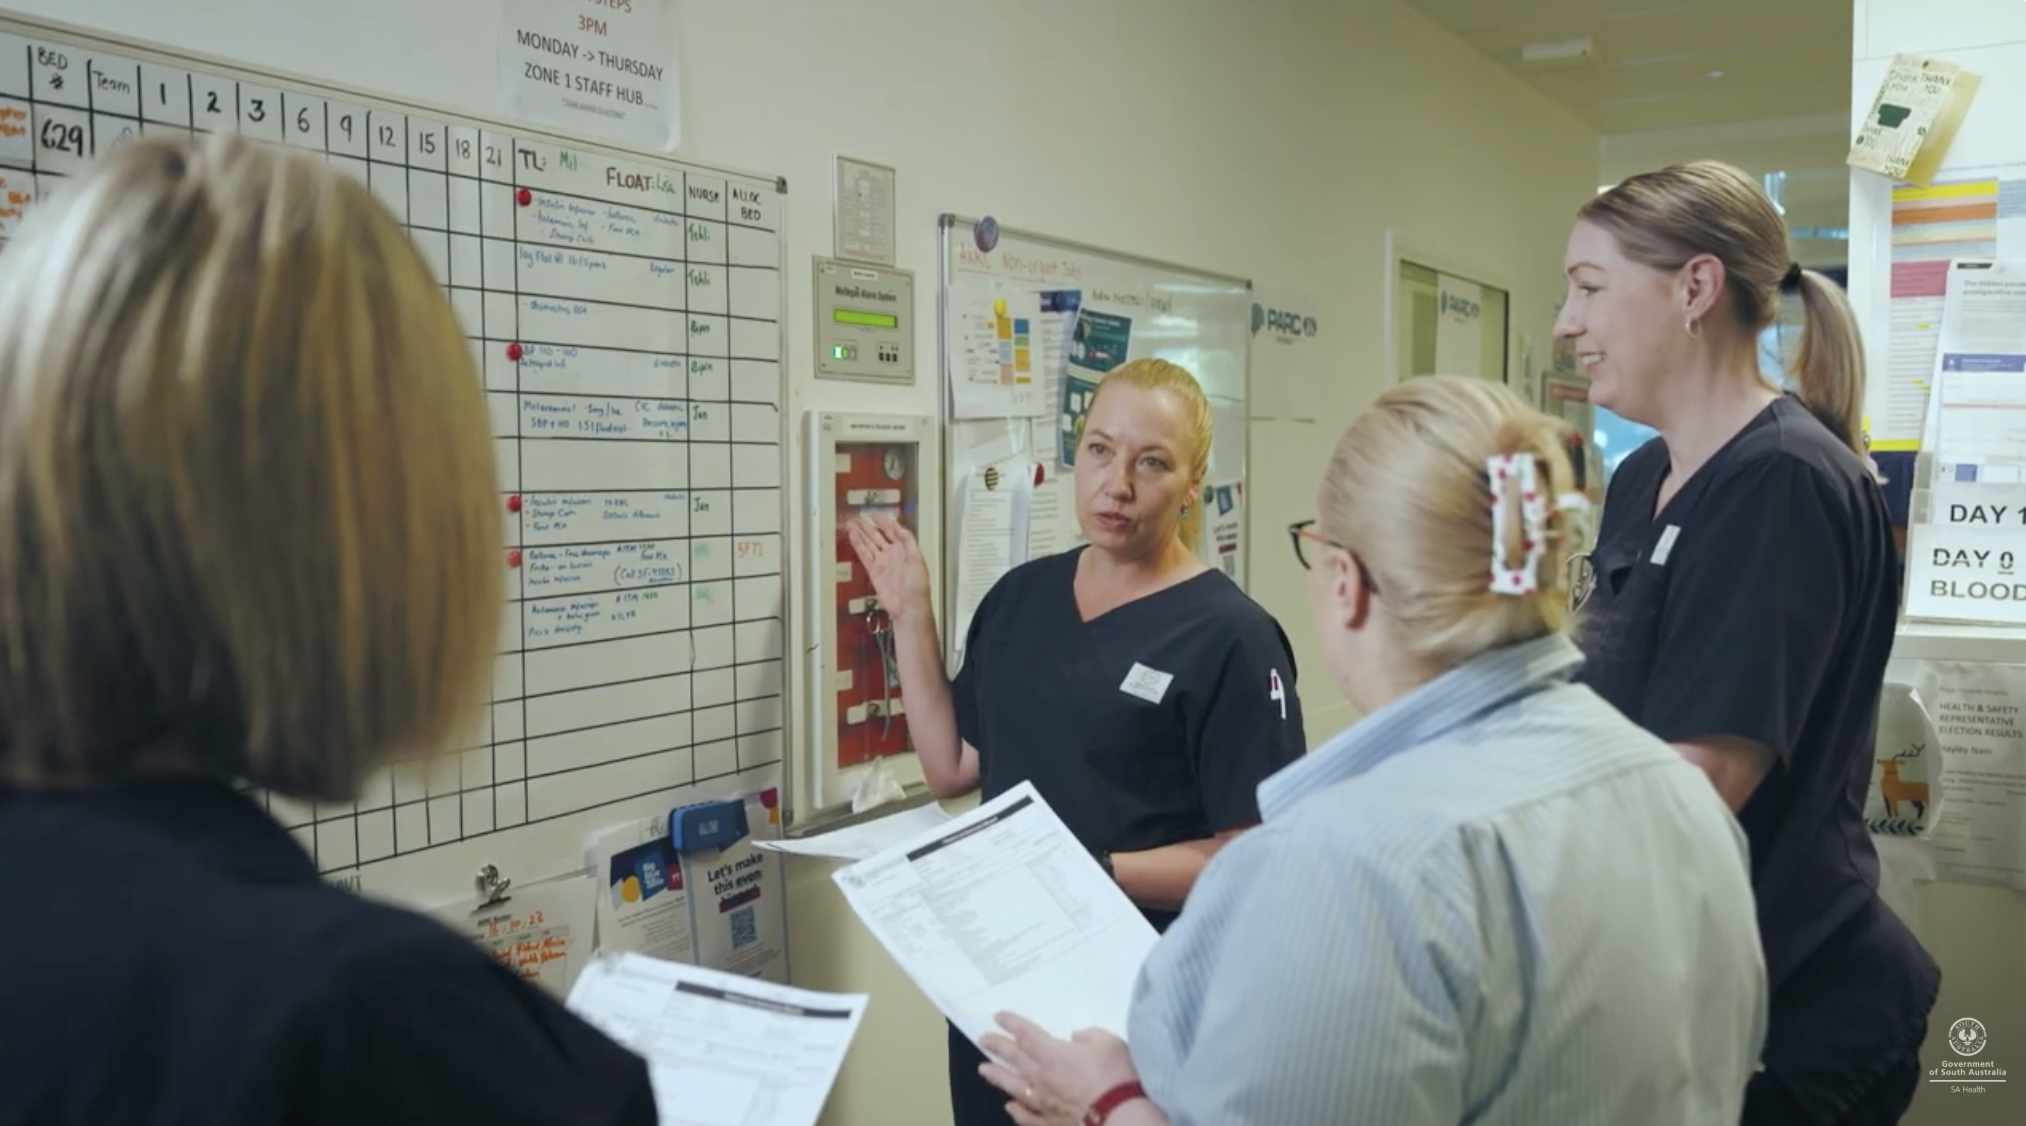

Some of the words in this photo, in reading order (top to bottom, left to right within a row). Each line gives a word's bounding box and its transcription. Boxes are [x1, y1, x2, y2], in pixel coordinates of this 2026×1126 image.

[578, 14, 607, 36] 3PM
[37, 46, 69, 71] BED
[516, 29, 579, 60] MONDAY
[597, 50, 664, 82] THURSDAY
[92, 70, 131, 95] Team
[524, 62, 561, 87] ZONE
[564, 72, 572, 89] 1
[574, 76, 614, 98] STAFF
[159, 82, 167, 106] 1
[207, 90, 222, 114] 2
[247, 98, 266, 123] 3
[296, 106, 312, 133] 6
[339, 113, 354, 143] 9
[378, 125, 396, 148] 12
[418, 131, 436, 155] 15
[455, 138, 471, 161] 18
[485, 146, 502, 167] 21
[740, 207, 762, 221] BED
[1267, 309, 1301, 336] PARC
[1950, 504, 2007, 524] DAY
[1933, 548, 1991, 568] DAY
[1939, 714, 2014, 726] REPRESENTATIVE
[1940, 702, 1975, 712] HEALTH
[1976, 704, 1984, 712] &
[1986, 704, 2019, 714] SAFETY
[1939, 725, 1982, 736] ELECTION
[1985, 728, 2024, 739] RESULTS
[707, 865, 733, 883] Let's
[735, 853, 764, 871] make
[714, 880, 735, 896] this
[736, 870, 762, 887] even
